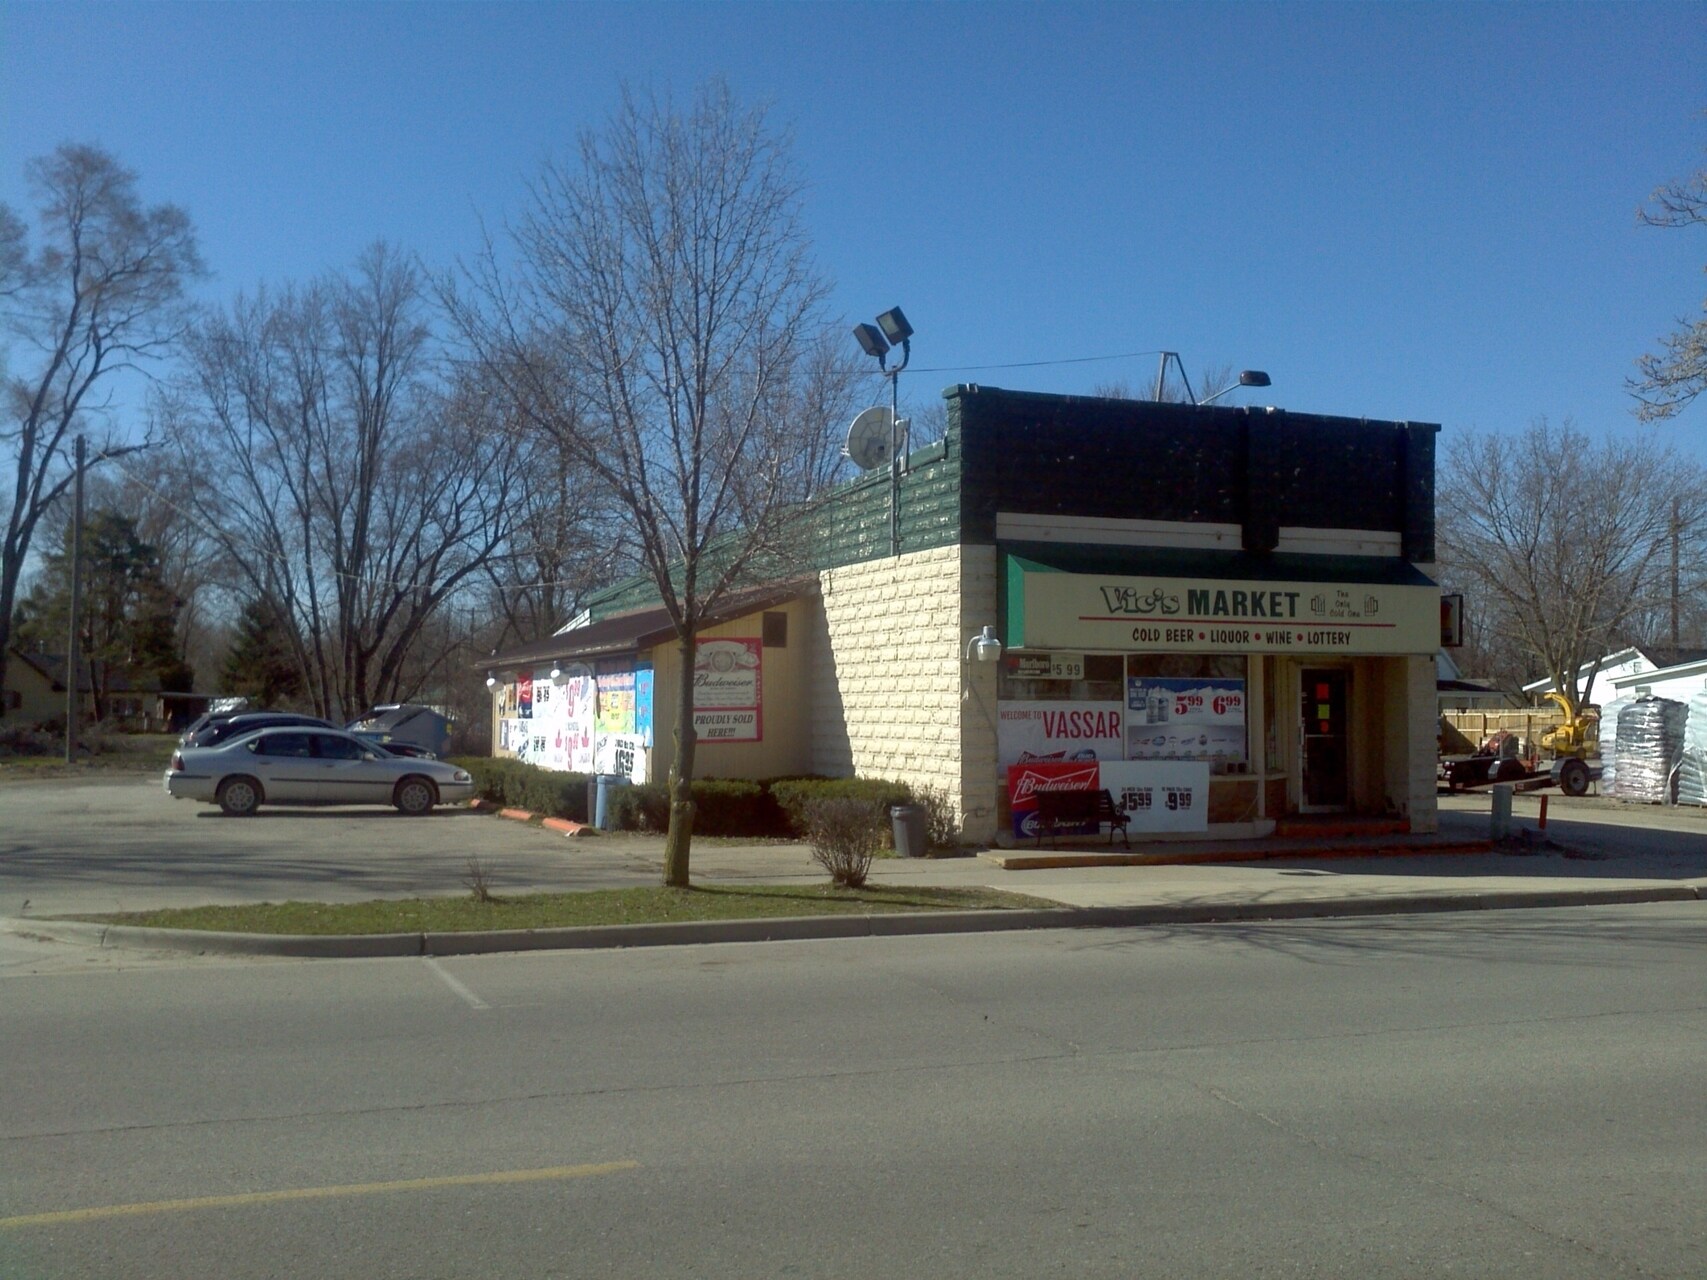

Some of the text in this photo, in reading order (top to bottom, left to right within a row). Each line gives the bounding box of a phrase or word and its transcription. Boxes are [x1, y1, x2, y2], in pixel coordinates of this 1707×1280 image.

[1100, 586, 1300, 617] Vic's MARKET
[1132, 628, 1351, 645] COLD BEER LIQUOR WINE LOTTERY
[693, 673, 753, 687] Budweiser
[695, 714, 753, 725] PROUDLY SOLD
[1000, 710, 1120, 738] WELCOME TO VASSAR
[1017, 777, 1088, 795] Budweiser
